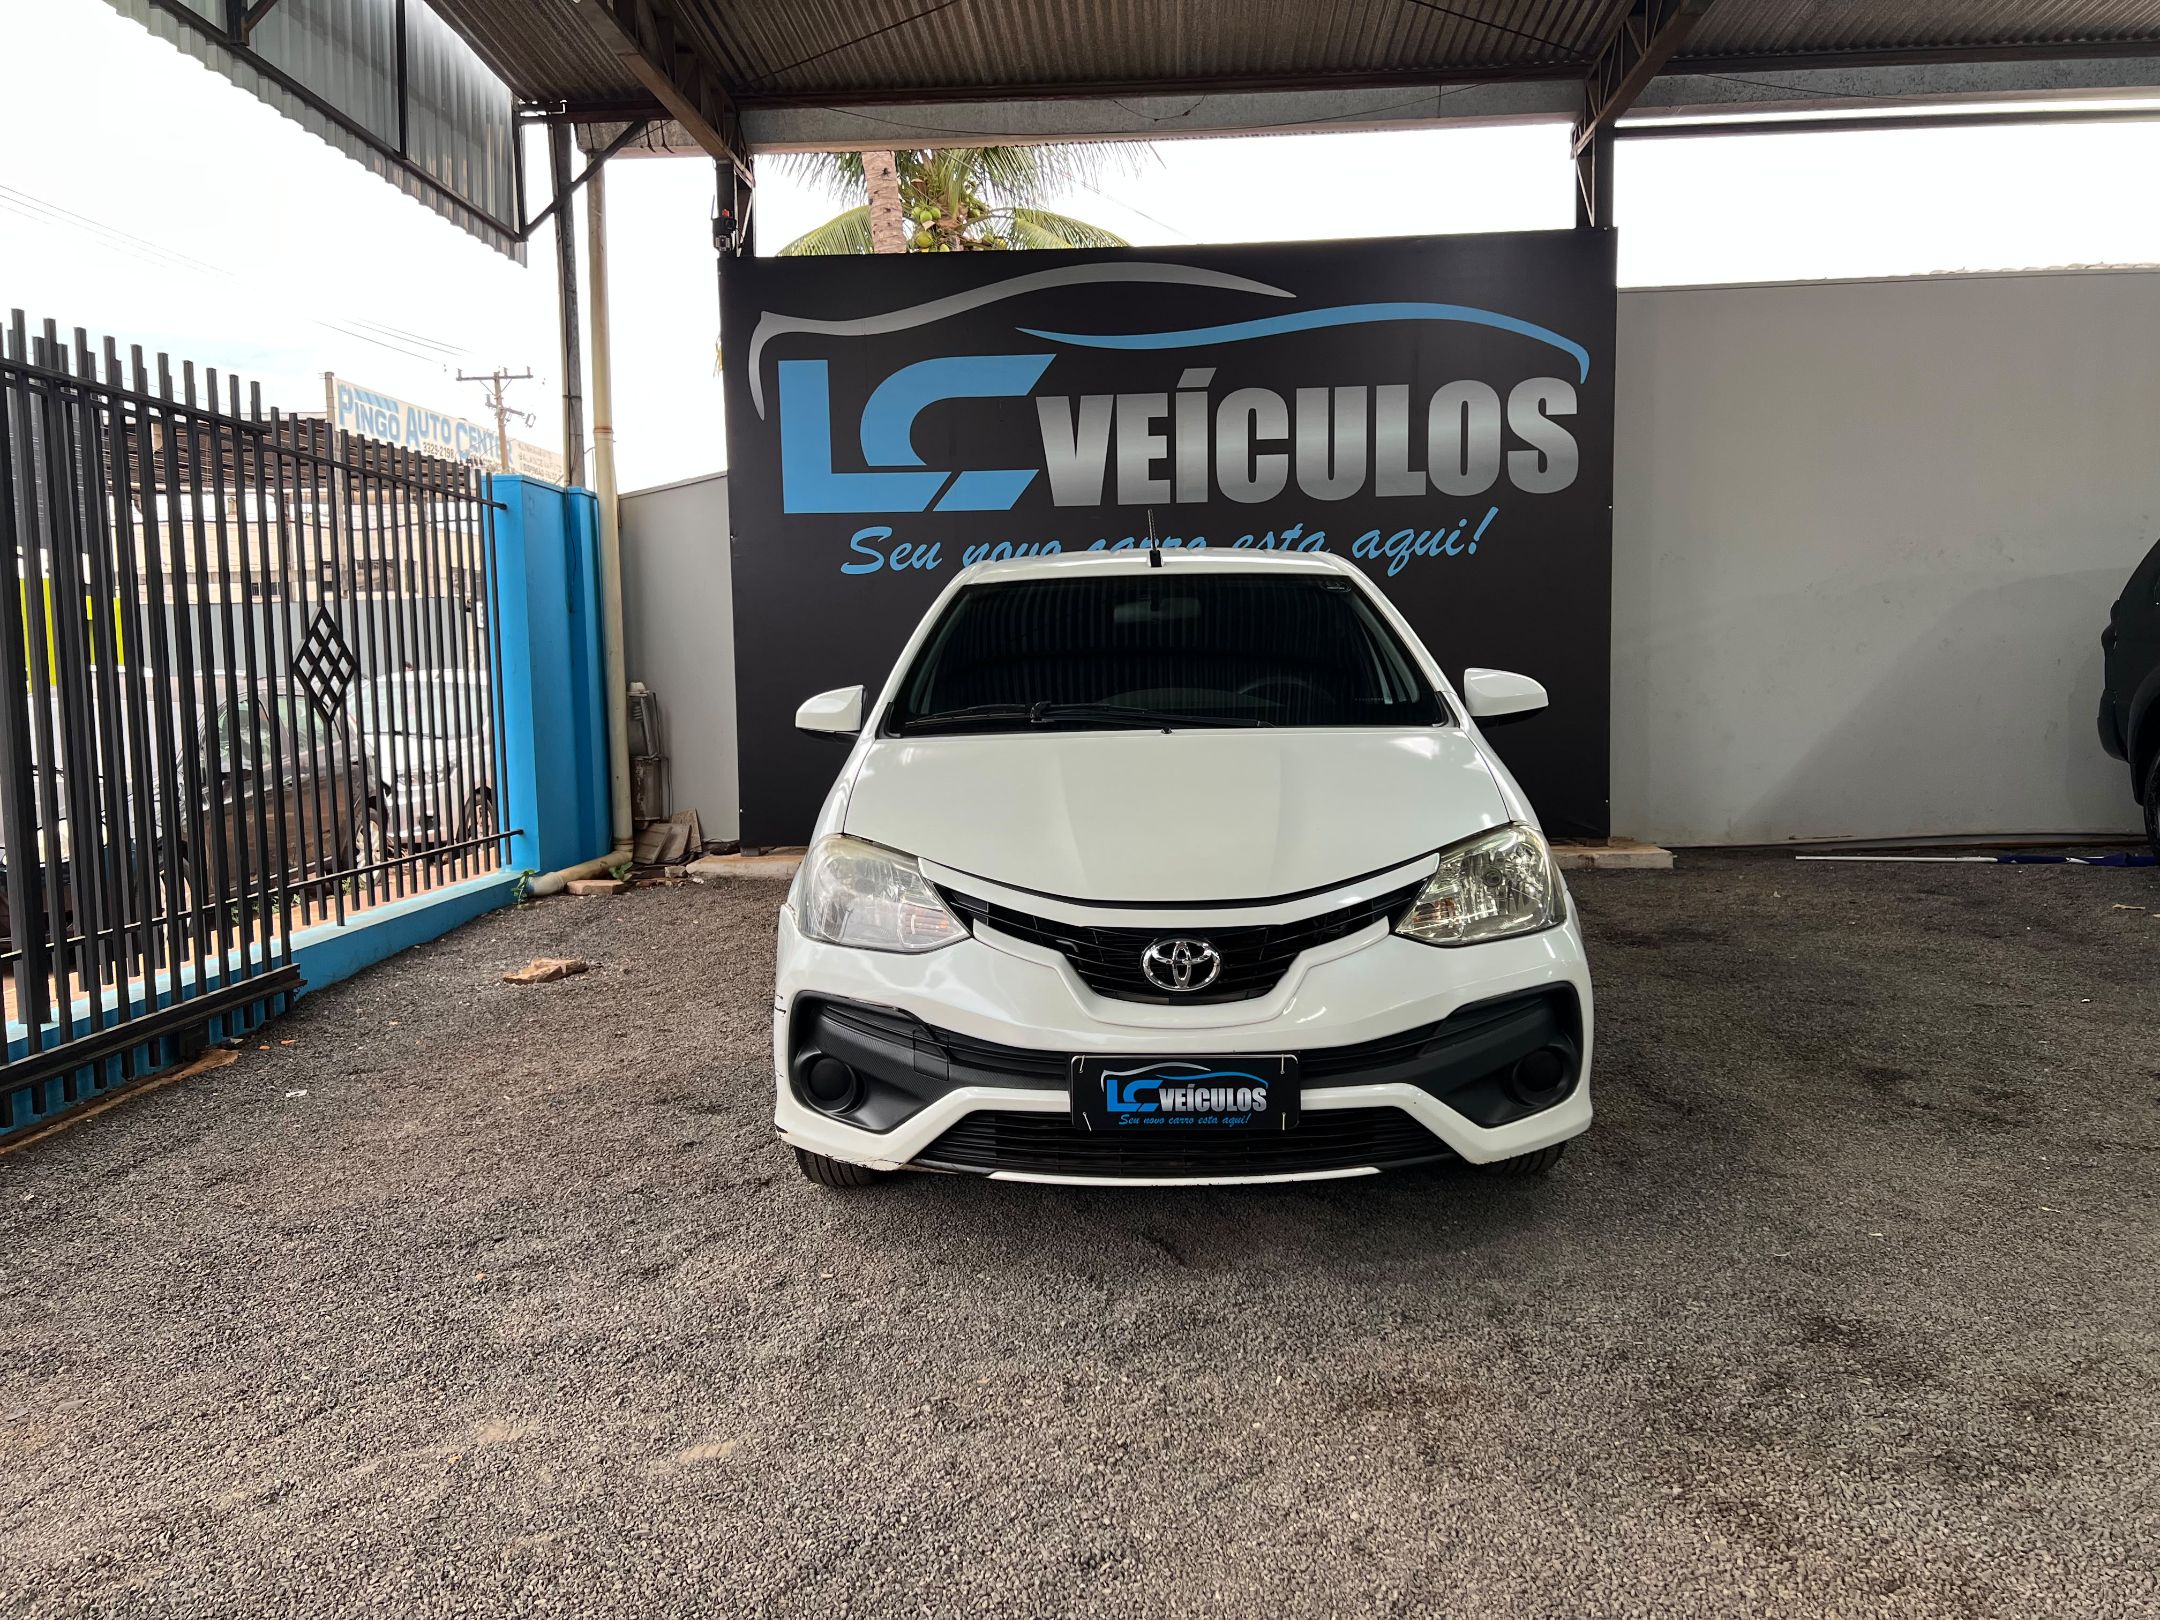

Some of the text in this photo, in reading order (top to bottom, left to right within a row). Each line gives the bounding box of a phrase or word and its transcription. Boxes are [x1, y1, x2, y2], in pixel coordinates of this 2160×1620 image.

[337, 384, 400, 443] PINGO
[406, 406, 452, 449] AUTO
[777, 353, 1580, 514] LC VEÍCULOS
[840, 526, 942, 575] Seu
[1351, 506, 1499, 577] aqui!
[1106, 1079, 1268, 1112] LC VEÍCULOS
[1118, 1113, 1252, 1128] Seu novo carro esta aqui!
